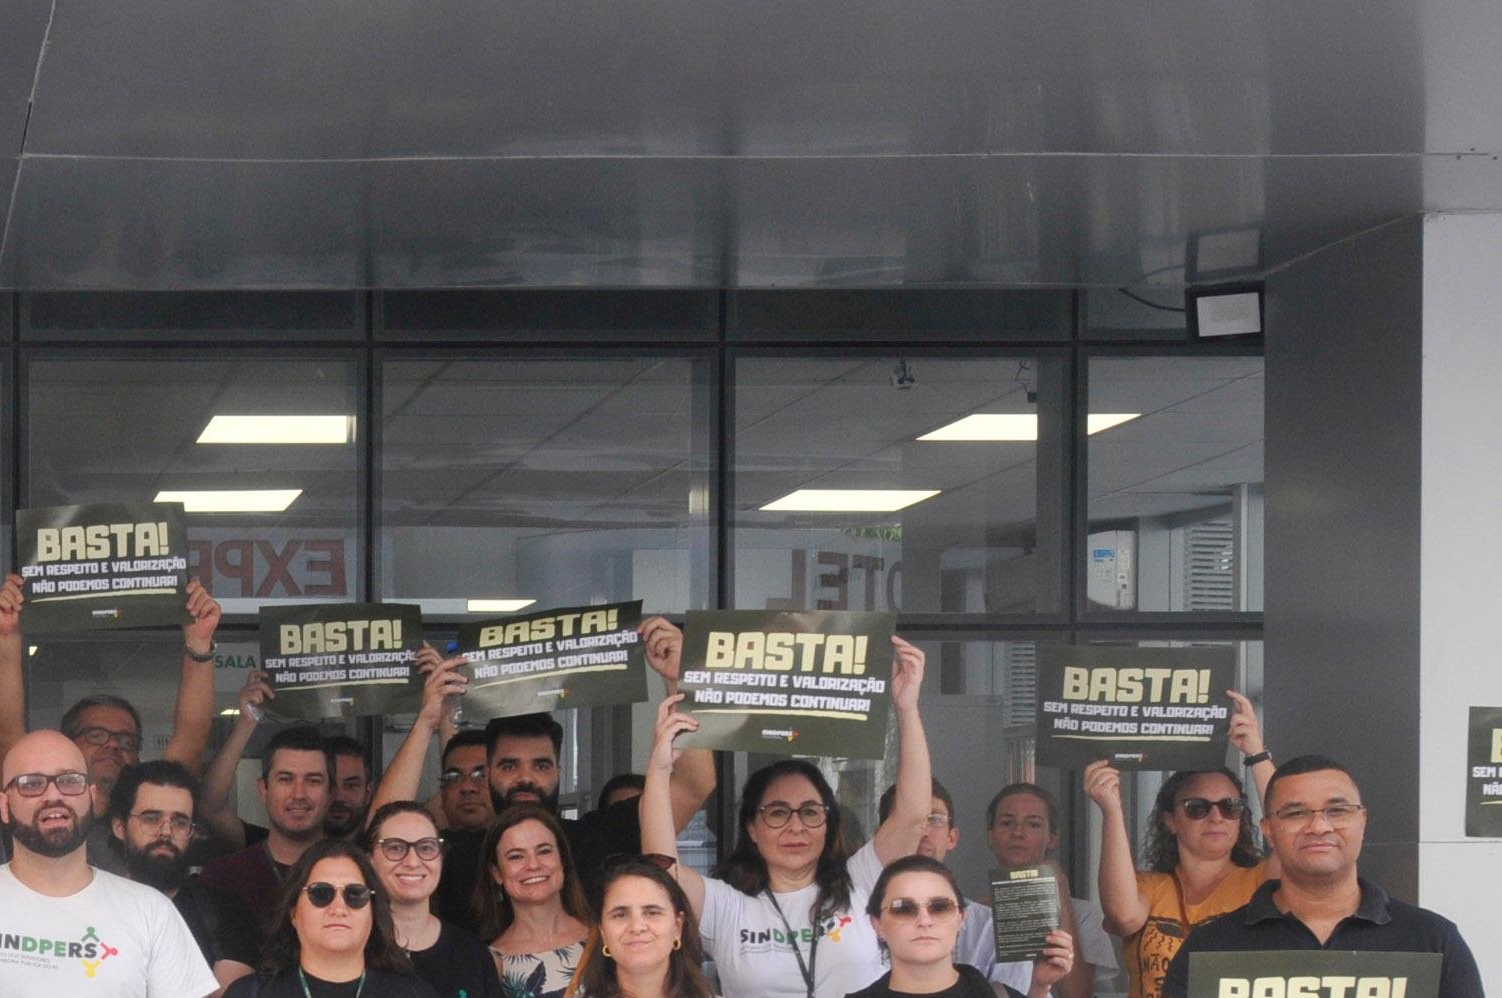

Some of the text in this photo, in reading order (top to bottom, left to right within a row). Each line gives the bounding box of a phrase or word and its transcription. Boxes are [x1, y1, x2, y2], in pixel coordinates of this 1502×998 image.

[38, 522, 169, 561] BASTA!
[22, 556, 186, 577] SEM RESPEITO VALORIZAÇÃO
[33, 576, 178, 593] NÃO PODEMOS CONTINUAR!
[280, 620, 402, 655] BASTA!
[480, 609, 618, 647] BASTA!
[488, 644, 543, 659] RESPEITO
[557, 630, 638, 647] VALORIZAÇÃO
[706, 632, 868, 675] BASTA!
[215, 655, 256, 669] SALA
[266, 655, 336, 668] SEM RESPEITO
[475, 650, 628, 679] NÃO PODEMOS CONTINUAR!
[276, 667, 409, 682] NÃO PODEMOS CONTINUAR!
[684, 671, 885, 695] SEM RESPEITO VALORIZAÇÃO
[1063, 667, 1211, 703] BASTA!
[695, 688, 871, 712] NÃO PODEMOS CONTINUAR!
[1044, 702, 1227, 721] SEM RESPEITO VALORIZAÇÃO
[1054, 717, 1214, 735] NÃO PODEMOS CONTINUAR!
[1473, 767, 1496, 777] SEM
